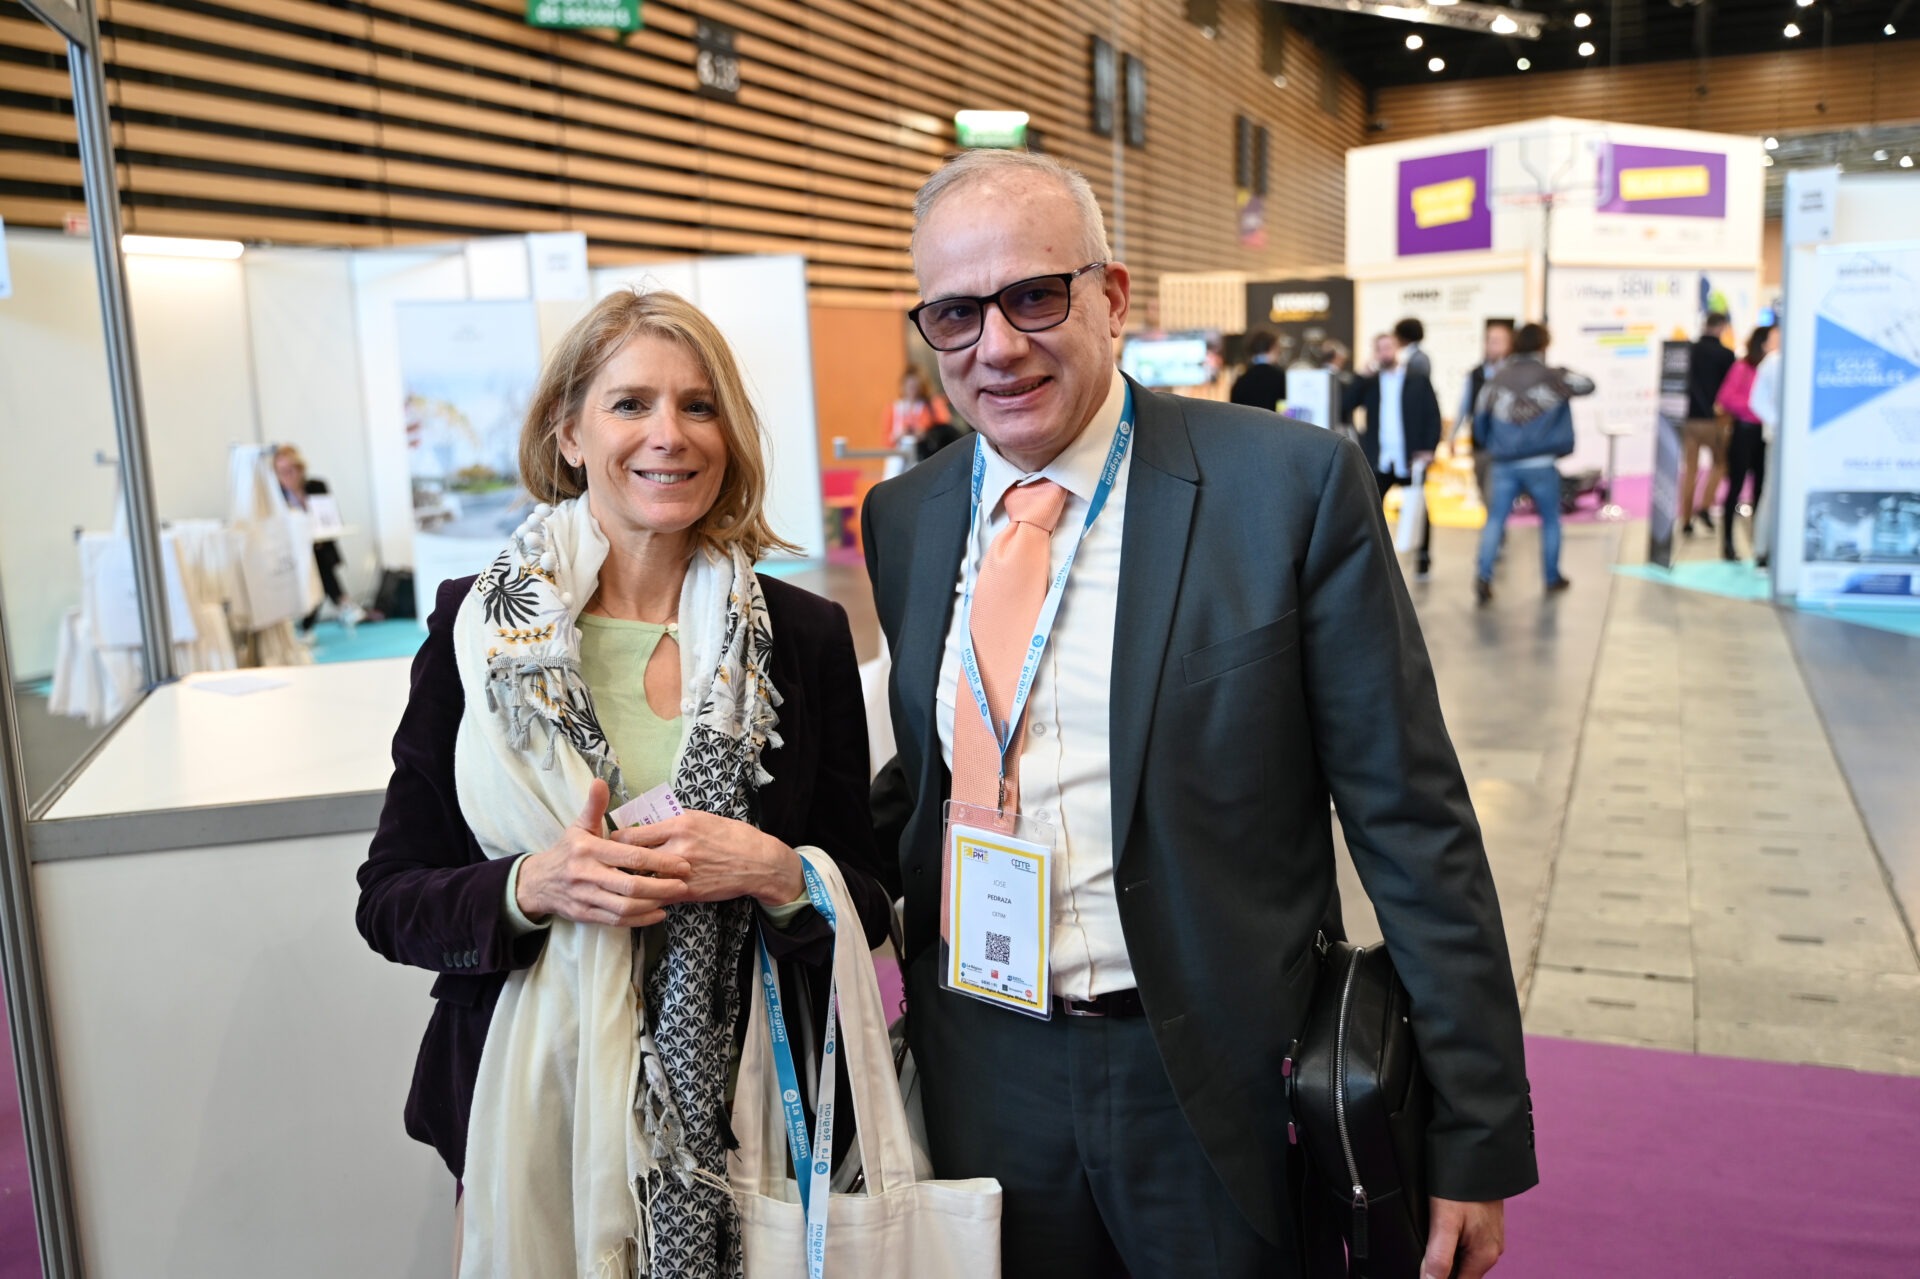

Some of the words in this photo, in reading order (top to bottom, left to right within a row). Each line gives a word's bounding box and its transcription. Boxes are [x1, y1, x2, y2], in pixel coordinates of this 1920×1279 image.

[1118, 435, 1128, 447] La
[1105, 451, 1124, 486] Région
[805, 870, 823, 907] Région
[987, 893, 1012, 905] PEDRAZA
[769, 988, 776, 999] La
[772, 1005, 785, 1043] Région
[791, 1103, 801, 1116] La
[795, 1120, 808, 1159] Région
